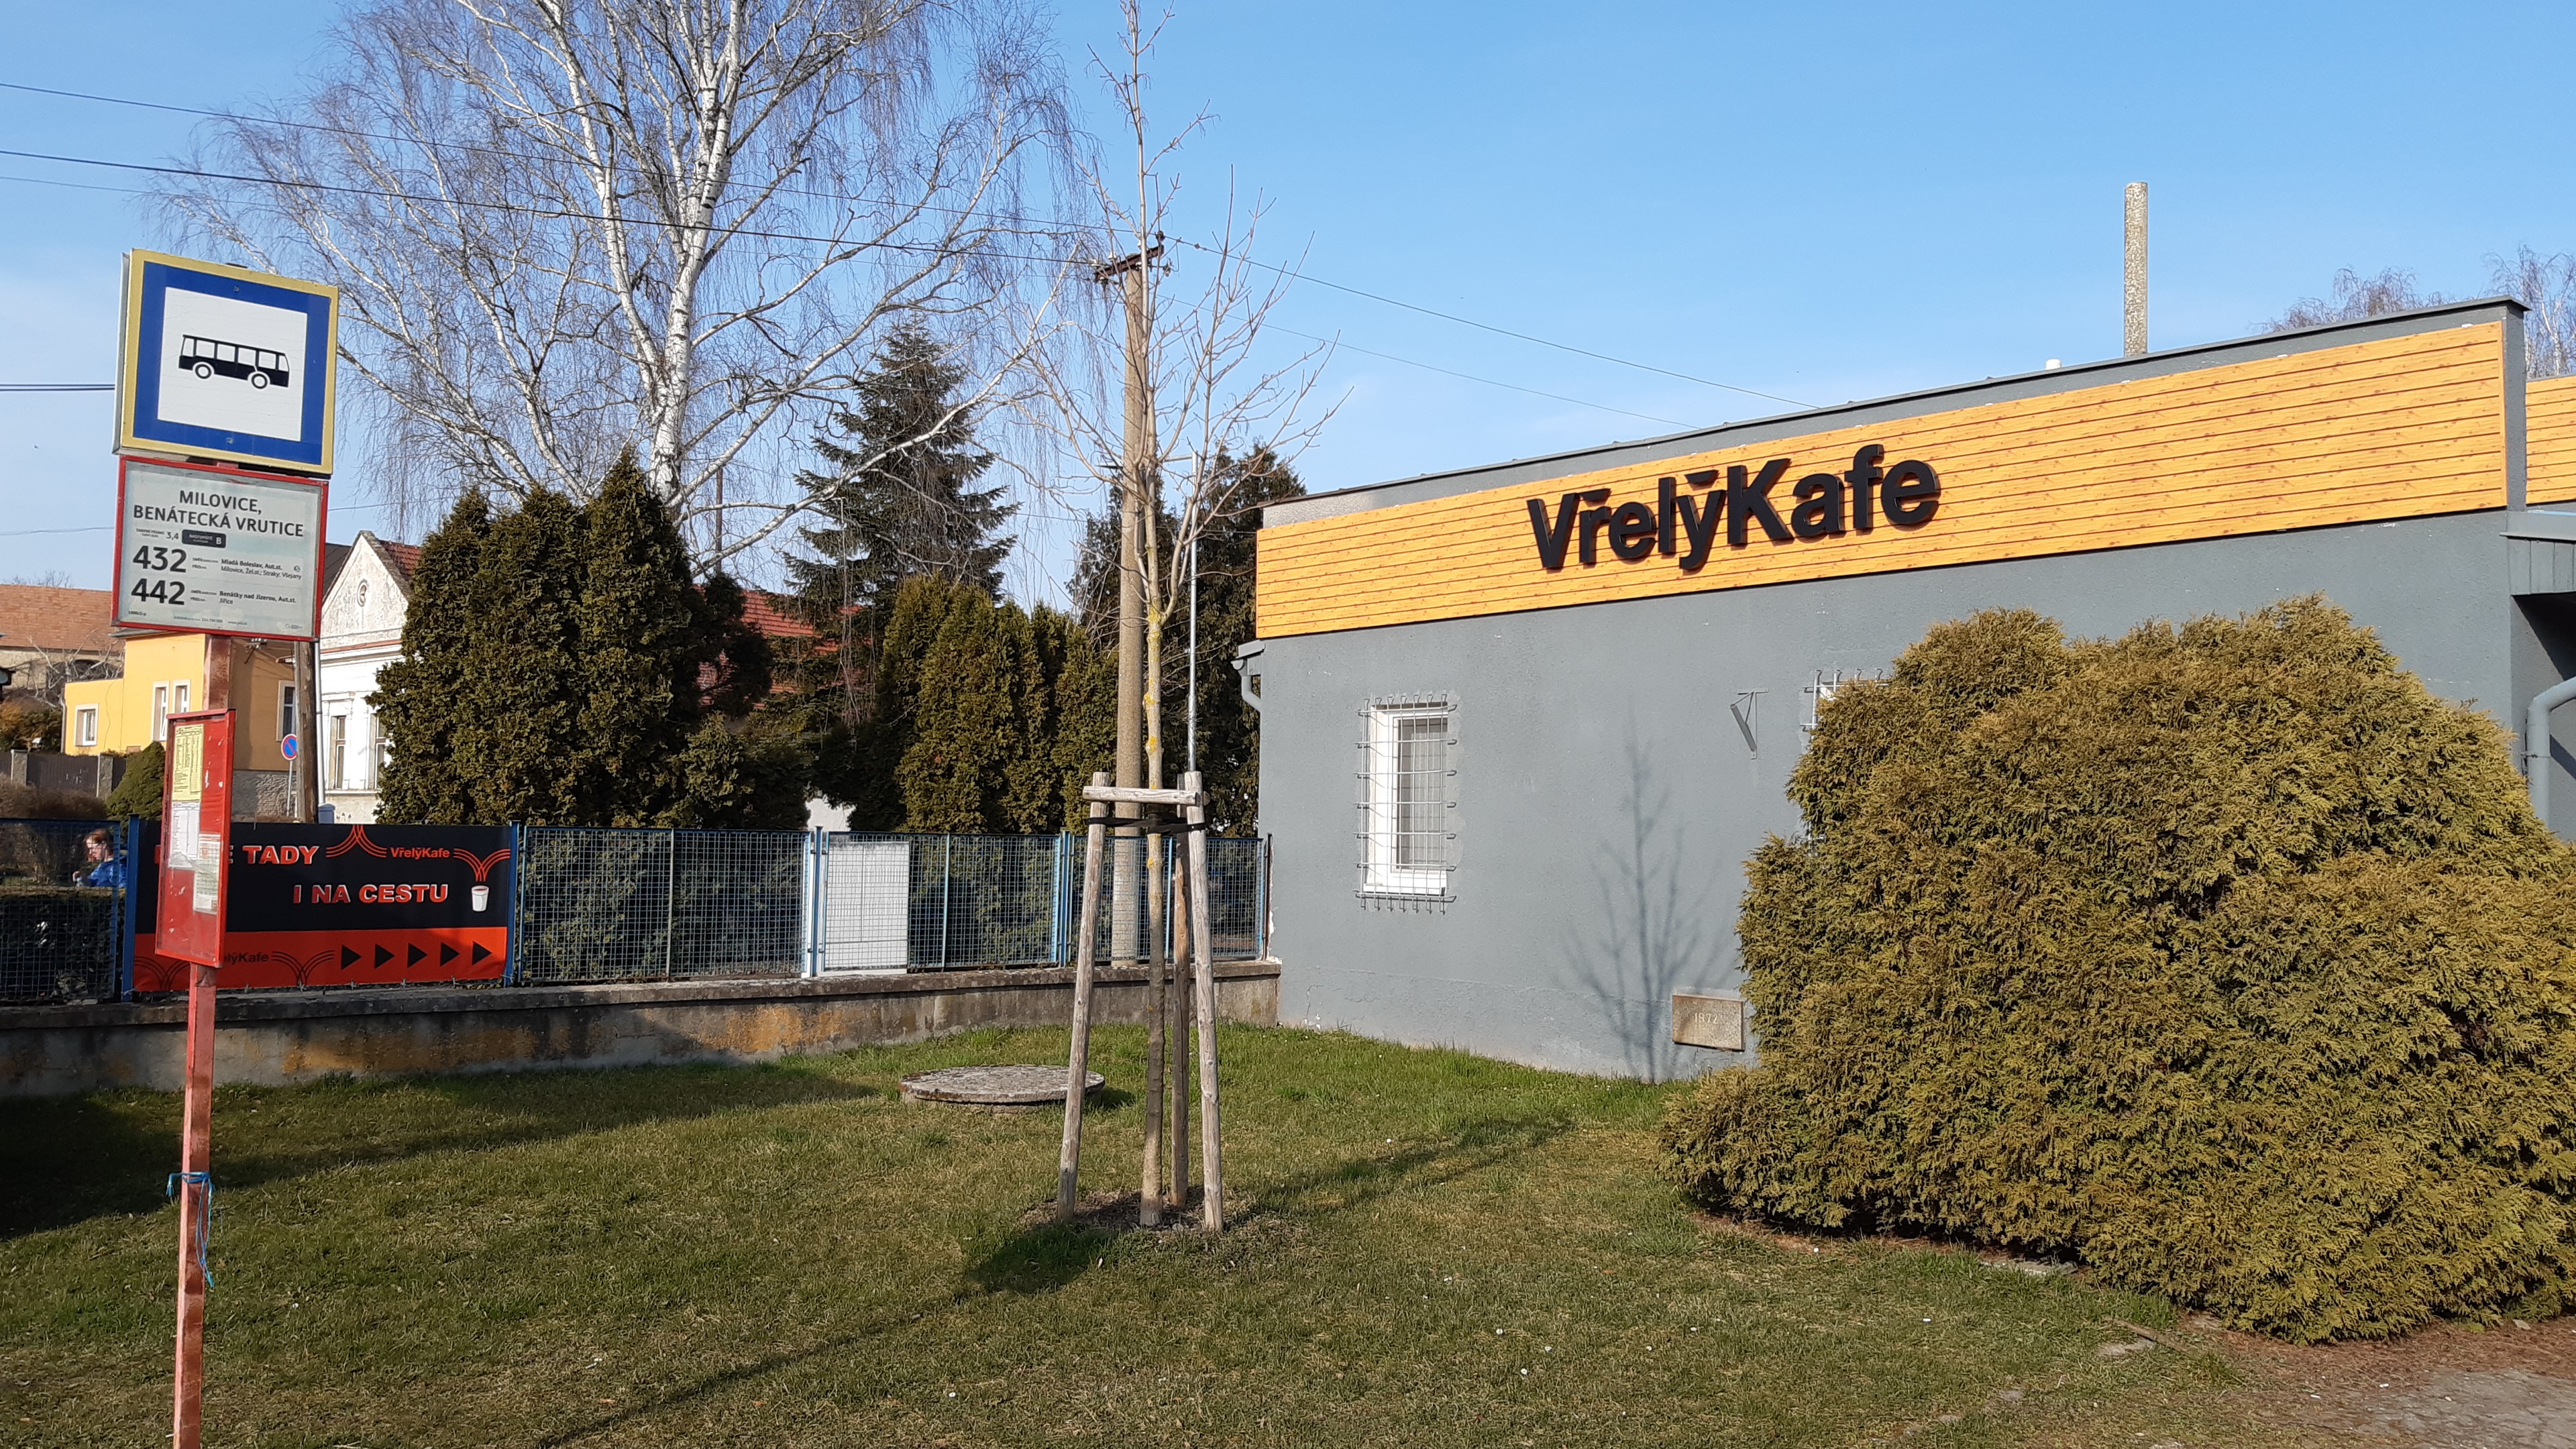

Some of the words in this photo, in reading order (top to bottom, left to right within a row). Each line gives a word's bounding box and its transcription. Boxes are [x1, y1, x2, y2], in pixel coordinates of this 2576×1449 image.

[179, 490, 262, 515] MILOVICE,
[133, 504, 231, 528] BENÁTECKÁ
[235, 517, 304, 537] VRUTICE
[166, 531, 179, 540] 3,4
[215, 537, 222, 545] B
[133, 545, 187, 573] 432
[239, 560, 264, 569] Boleslav,
[282, 572, 301, 580] Všejany
[131, 578, 185, 605] 442
[219, 590, 243, 599] Benátky
[256, 594, 277, 602] Jizerou,
[242, 845, 319, 865] TADY
[292, 885, 302, 904] I
[311, 885, 351, 904] NA
[358, 884, 448, 904] CESTU
[1695, 1012, 1719, 1024] 1972
